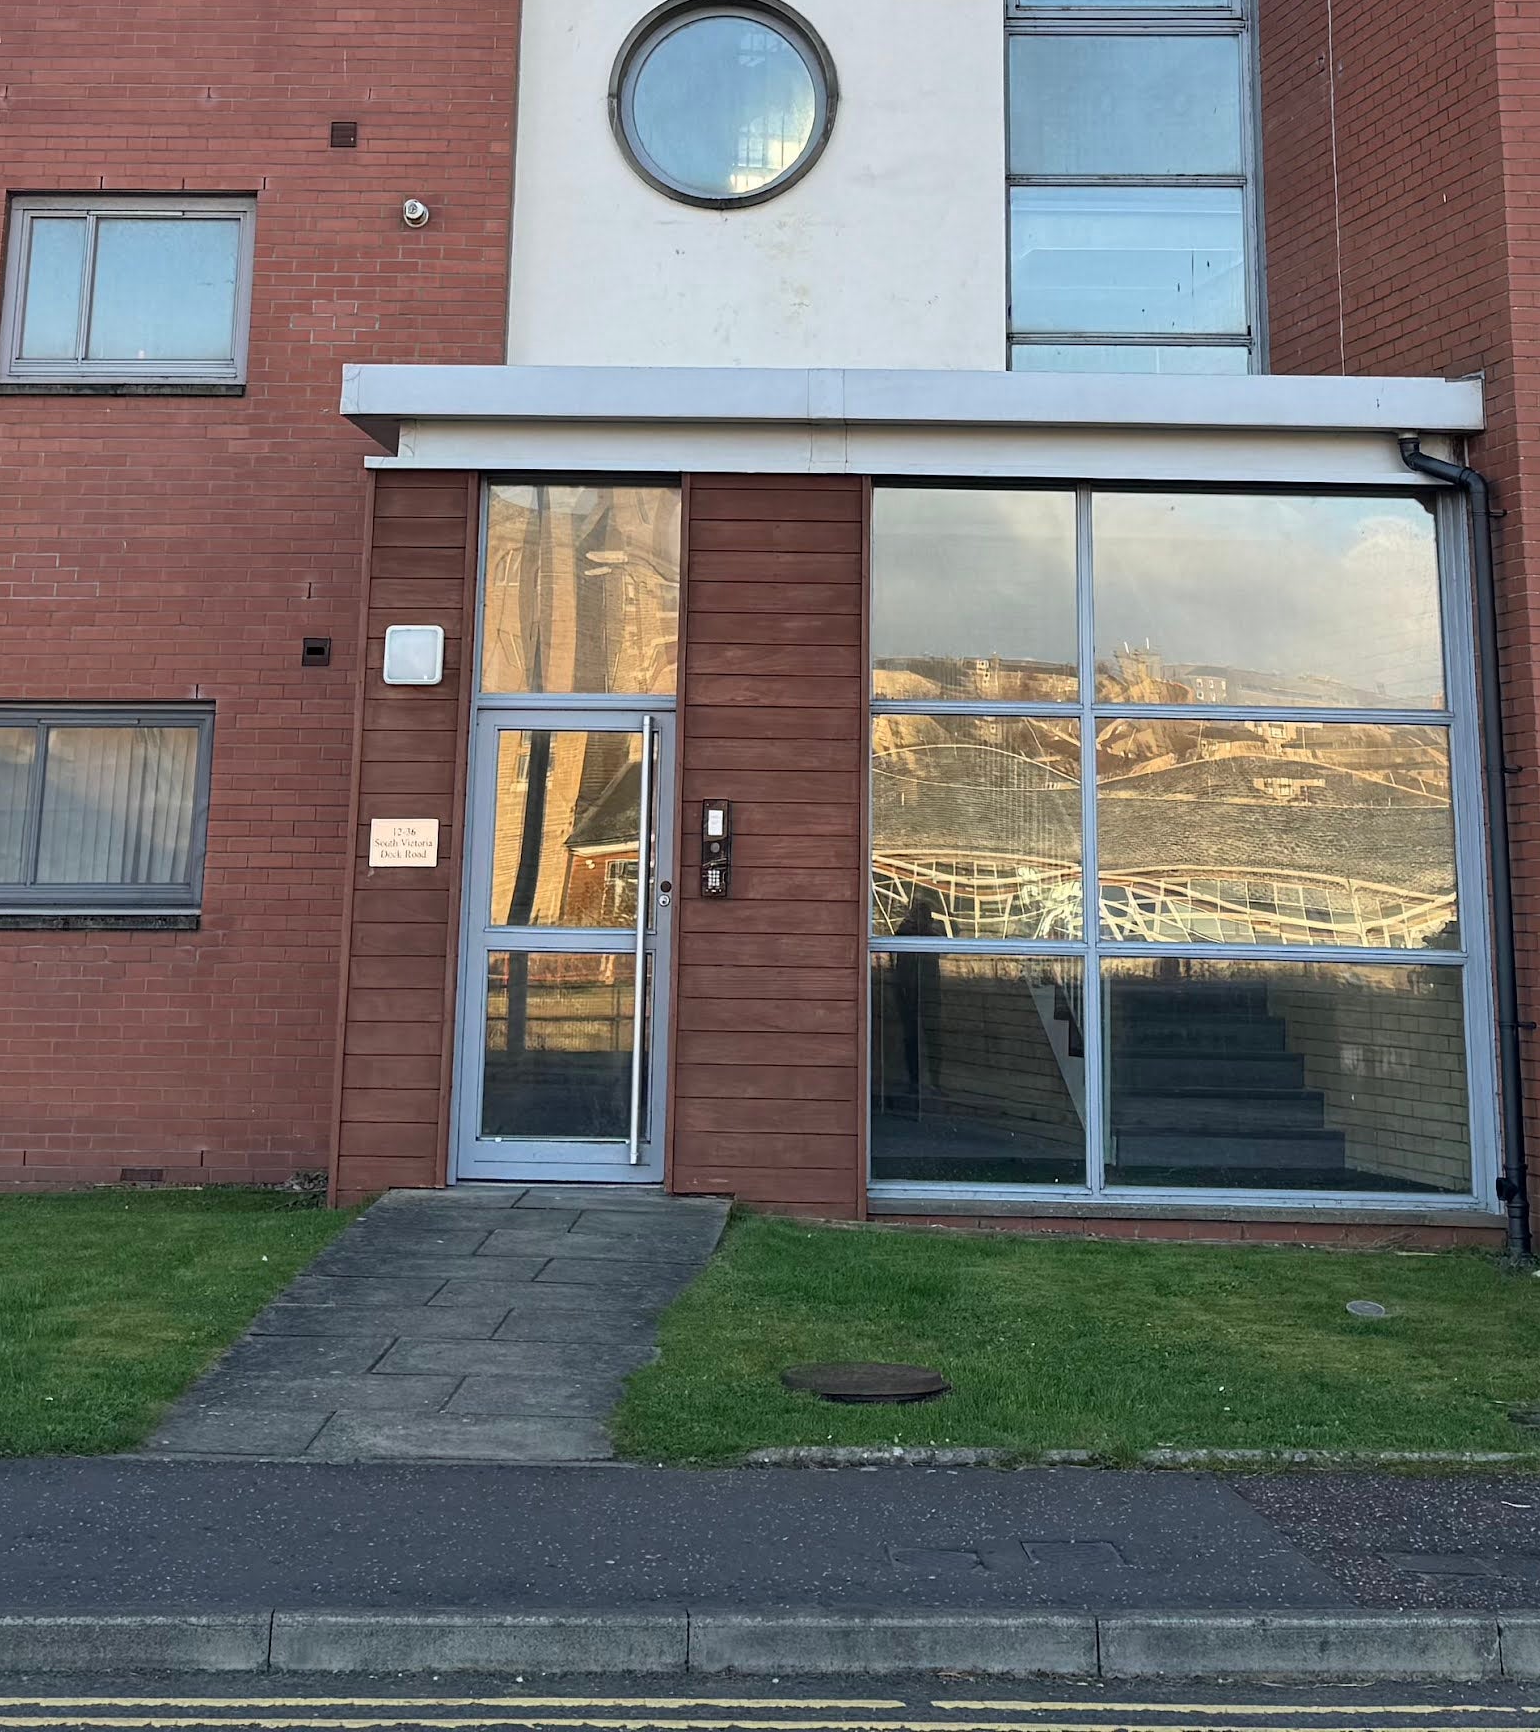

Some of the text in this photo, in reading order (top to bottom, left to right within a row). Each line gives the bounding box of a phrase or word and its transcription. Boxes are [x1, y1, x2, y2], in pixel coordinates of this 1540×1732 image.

[374, 838, 433, 847] South Victoria
[405, 849, 427, 859] Road
